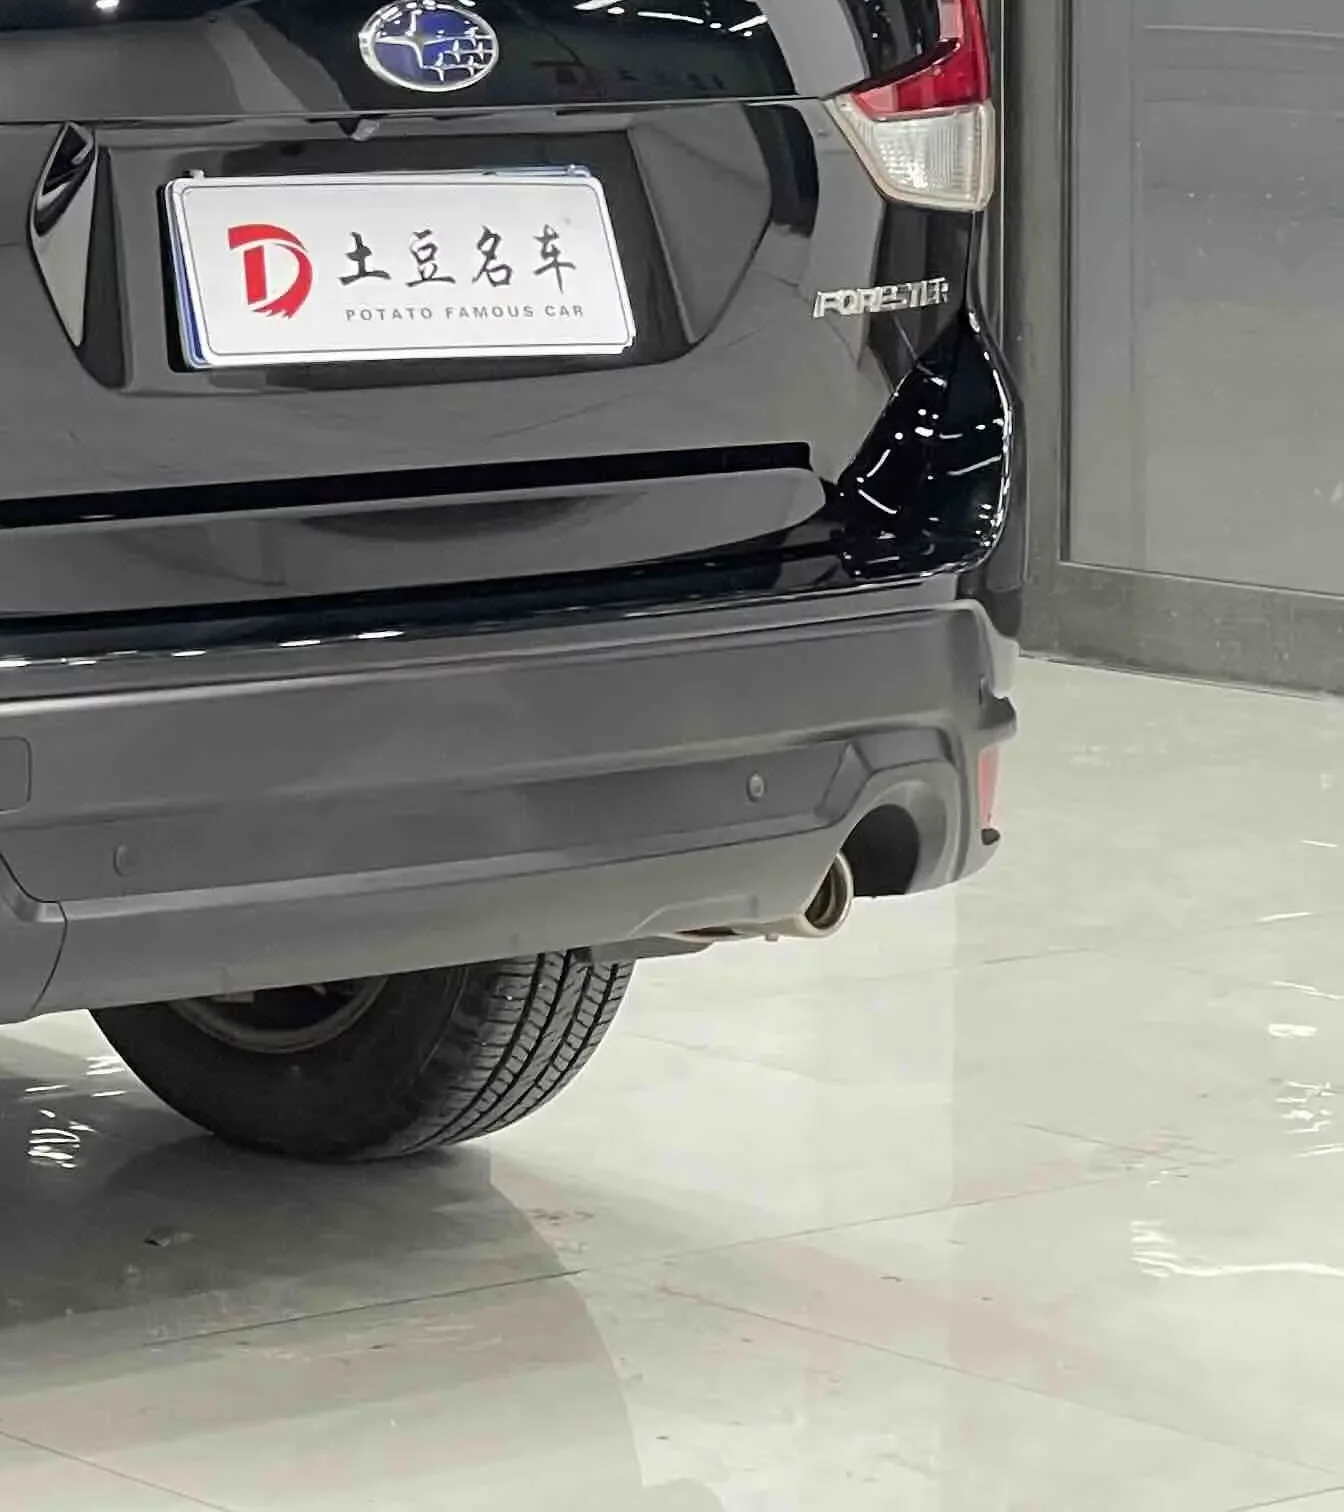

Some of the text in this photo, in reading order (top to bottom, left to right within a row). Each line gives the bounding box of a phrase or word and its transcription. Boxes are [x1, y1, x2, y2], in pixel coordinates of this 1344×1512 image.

[337, 224, 577, 294] 土豆名车
[345, 304, 585, 322] POTATO FAMOUS CAR
